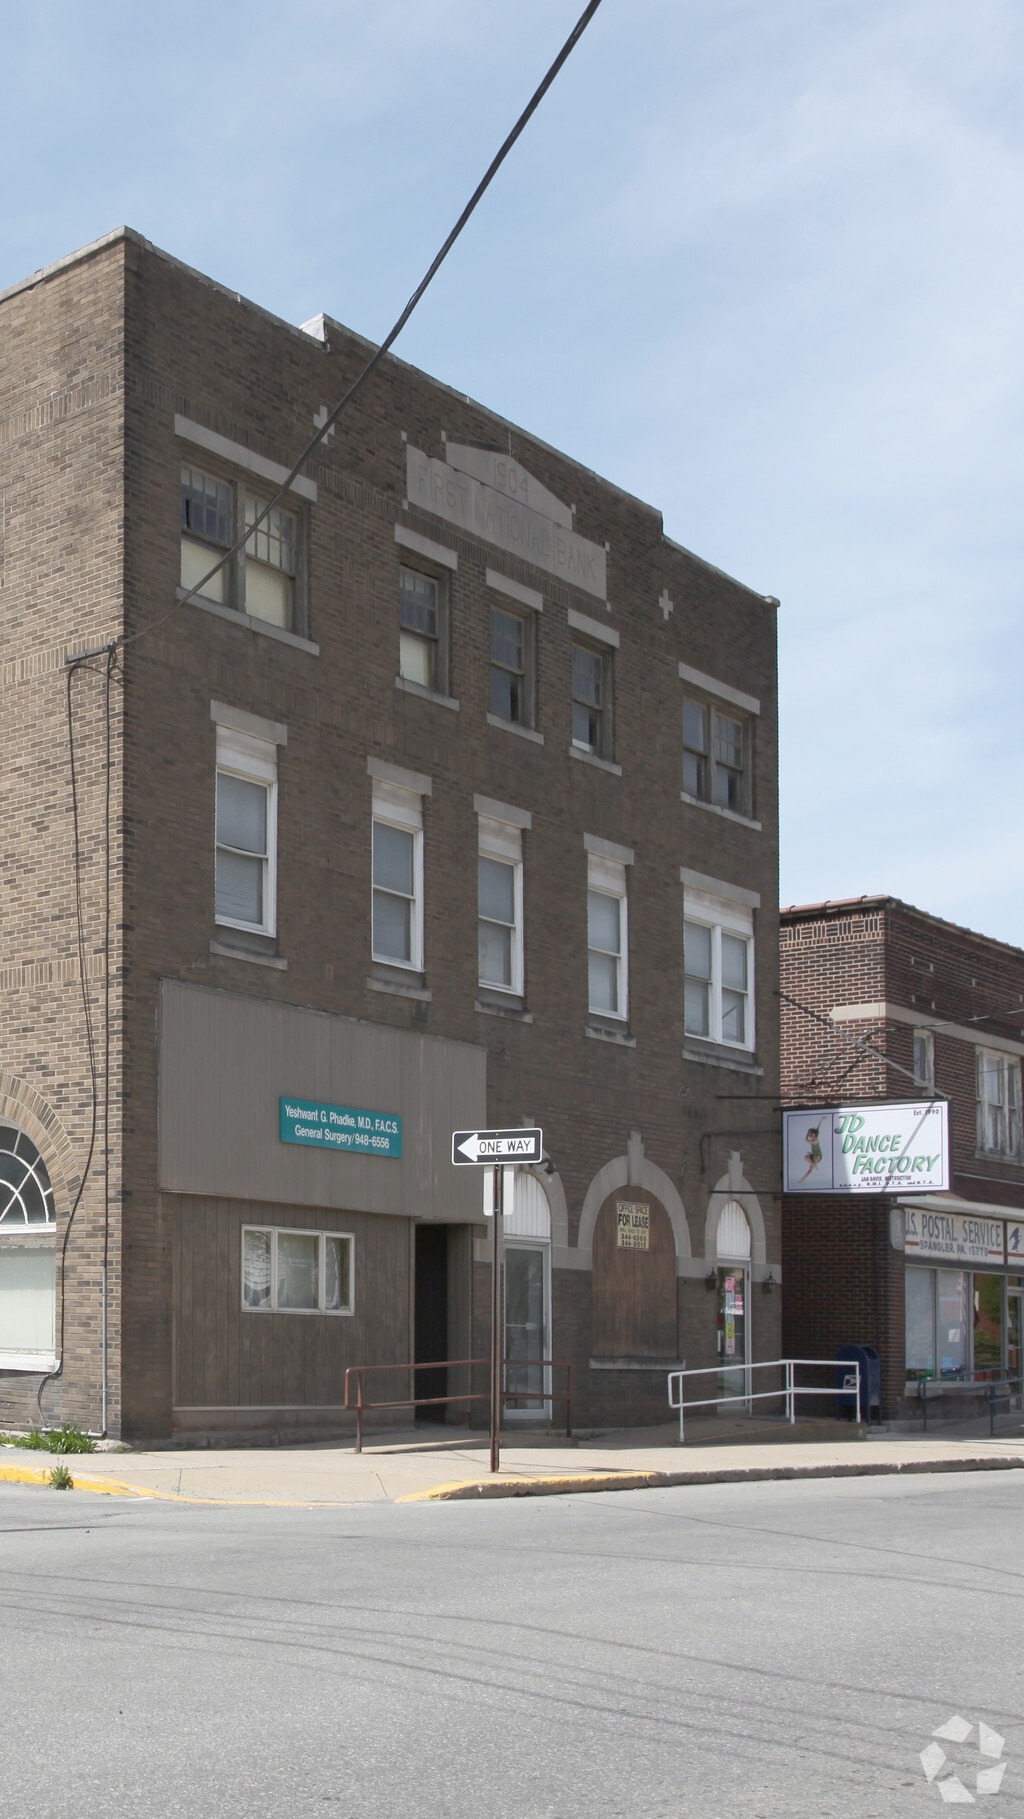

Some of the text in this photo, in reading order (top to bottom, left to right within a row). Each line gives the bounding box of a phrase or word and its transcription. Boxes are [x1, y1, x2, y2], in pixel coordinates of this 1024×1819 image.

[418, 464, 596, 580] FIRST NATIONAL BANK
[285, 1104, 399, 1134] Yeshwant G. Phadke, M.D., F.A.C.S.
[294, 1124, 323, 1139] General
[479, 1140, 531, 1154] ONE WAY
[841, 1134, 902, 1155] DANCE
[852, 1153, 941, 1175] FACTORY
[618, 1204, 633, 1214] OFFICE
[618, 1214, 648, 1229] FOR LEASE
[922, 1213, 957, 1242] POSTAL
[963, 1219, 1001, 1248] SERVICE
